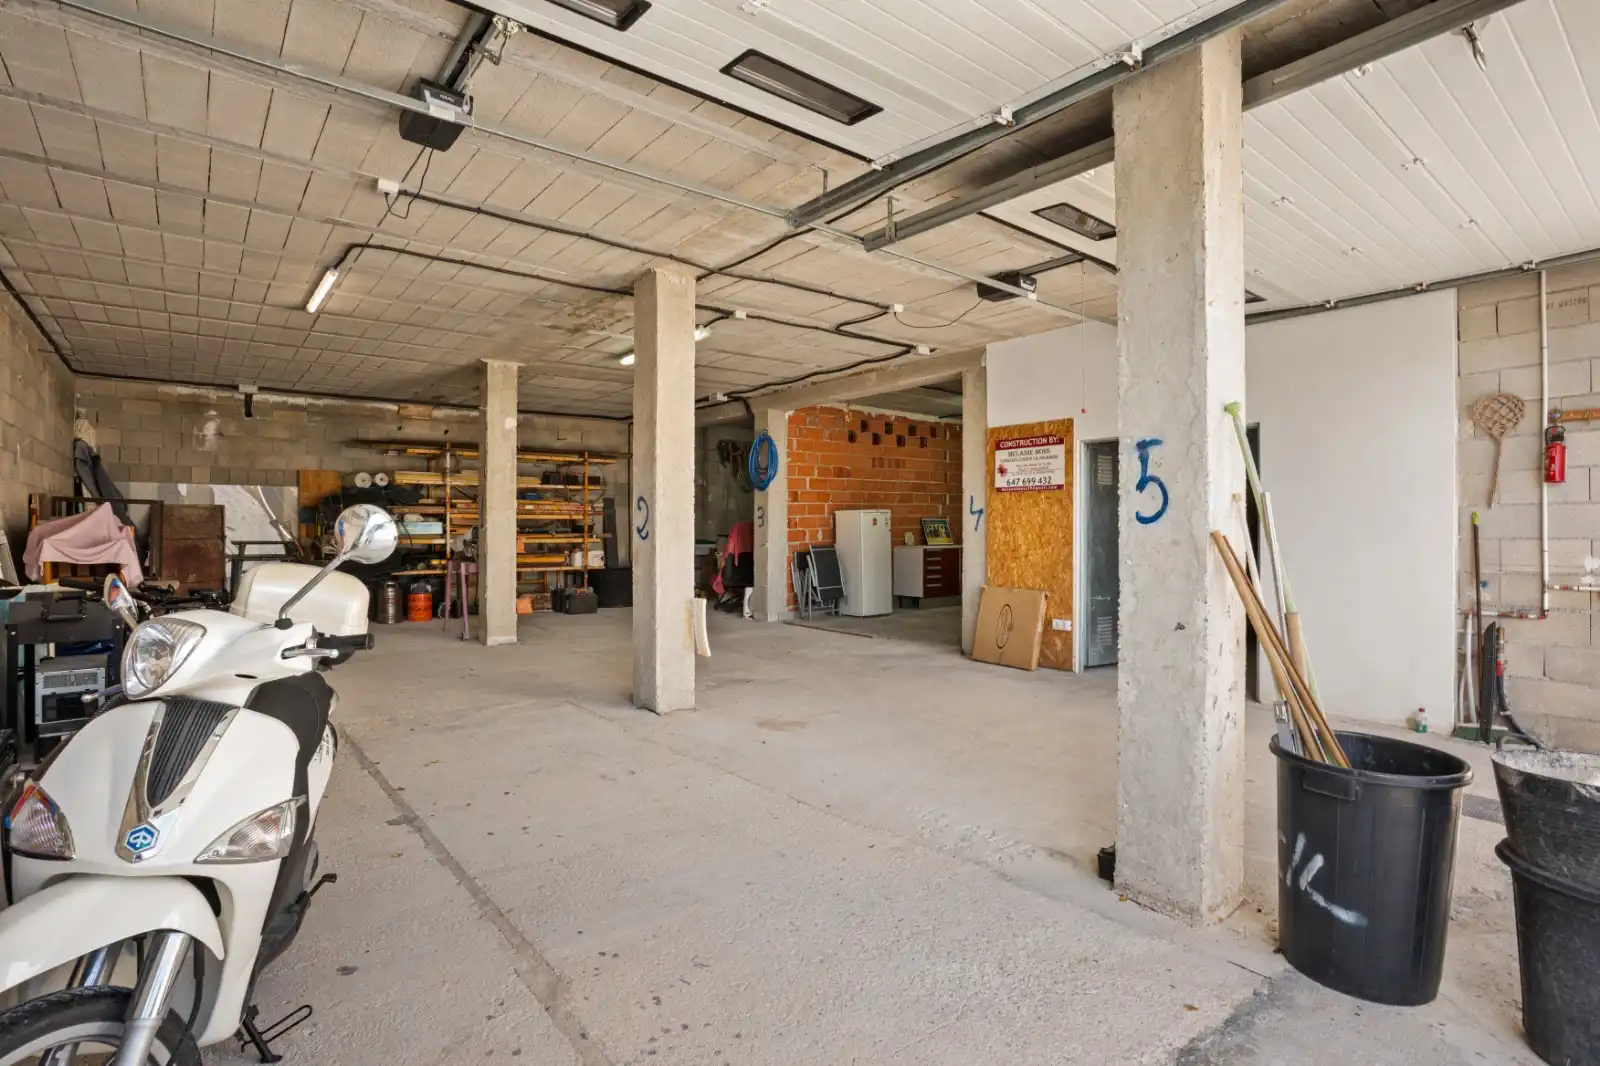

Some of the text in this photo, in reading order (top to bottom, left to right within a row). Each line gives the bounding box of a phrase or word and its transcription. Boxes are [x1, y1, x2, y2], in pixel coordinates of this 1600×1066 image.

[999, 435, 1060, 448] CONSTRUCTION BY:
[1006, 476, 1052, 487] 647 699 432
[1135, 438, 1168, 525] 5
[636, 495, 649, 541] 2
[757, 506, 765, 528] 3
[970, 494, 984, 532] 4
